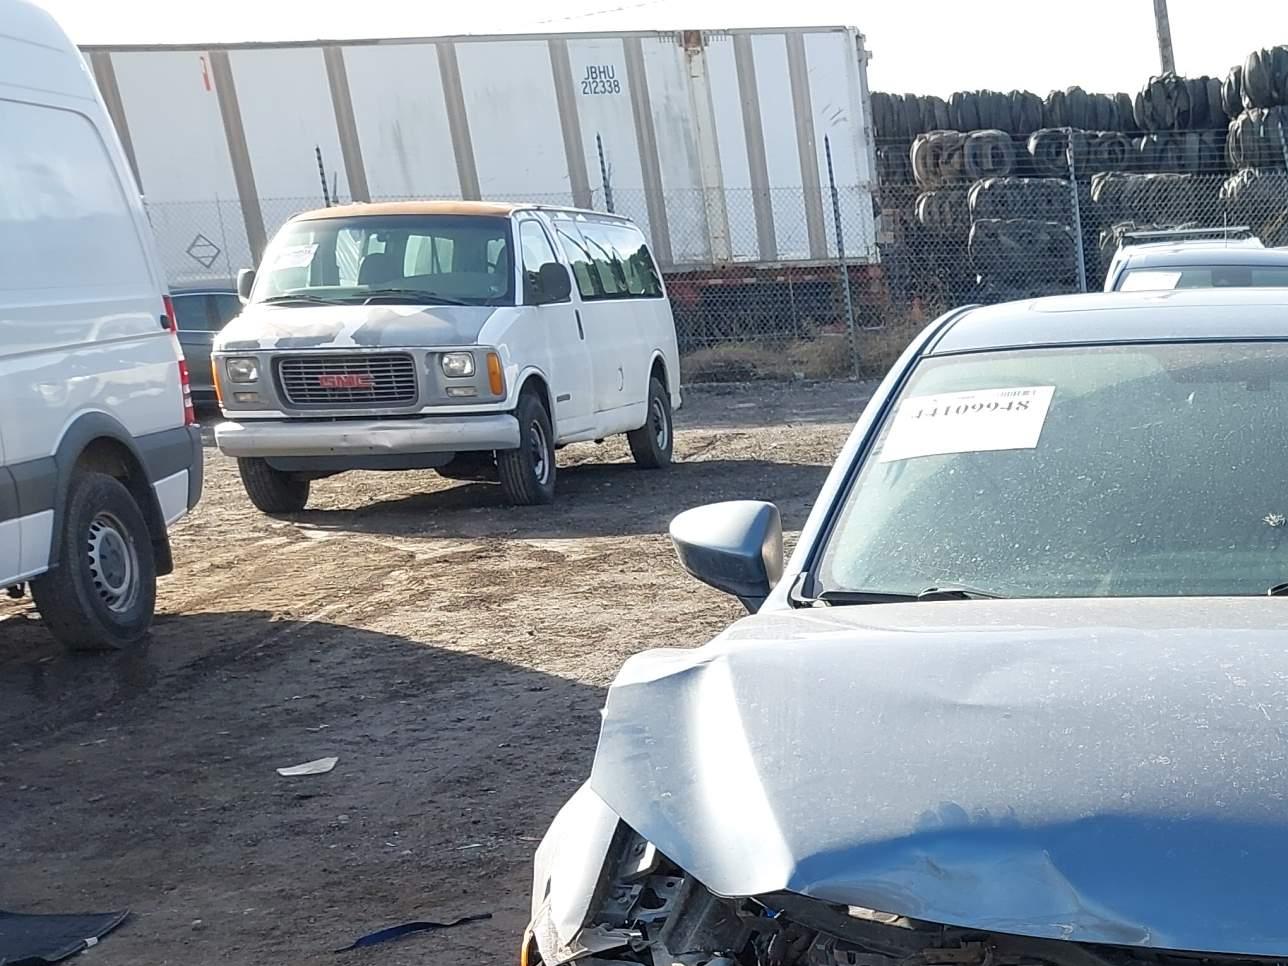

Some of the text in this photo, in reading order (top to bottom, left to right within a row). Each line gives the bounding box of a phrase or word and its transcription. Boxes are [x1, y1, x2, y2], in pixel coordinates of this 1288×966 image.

[584, 65, 615, 80] JBHU
[581, 80, 621, 95] 212338
[319, 374, 376, 388] GMC
